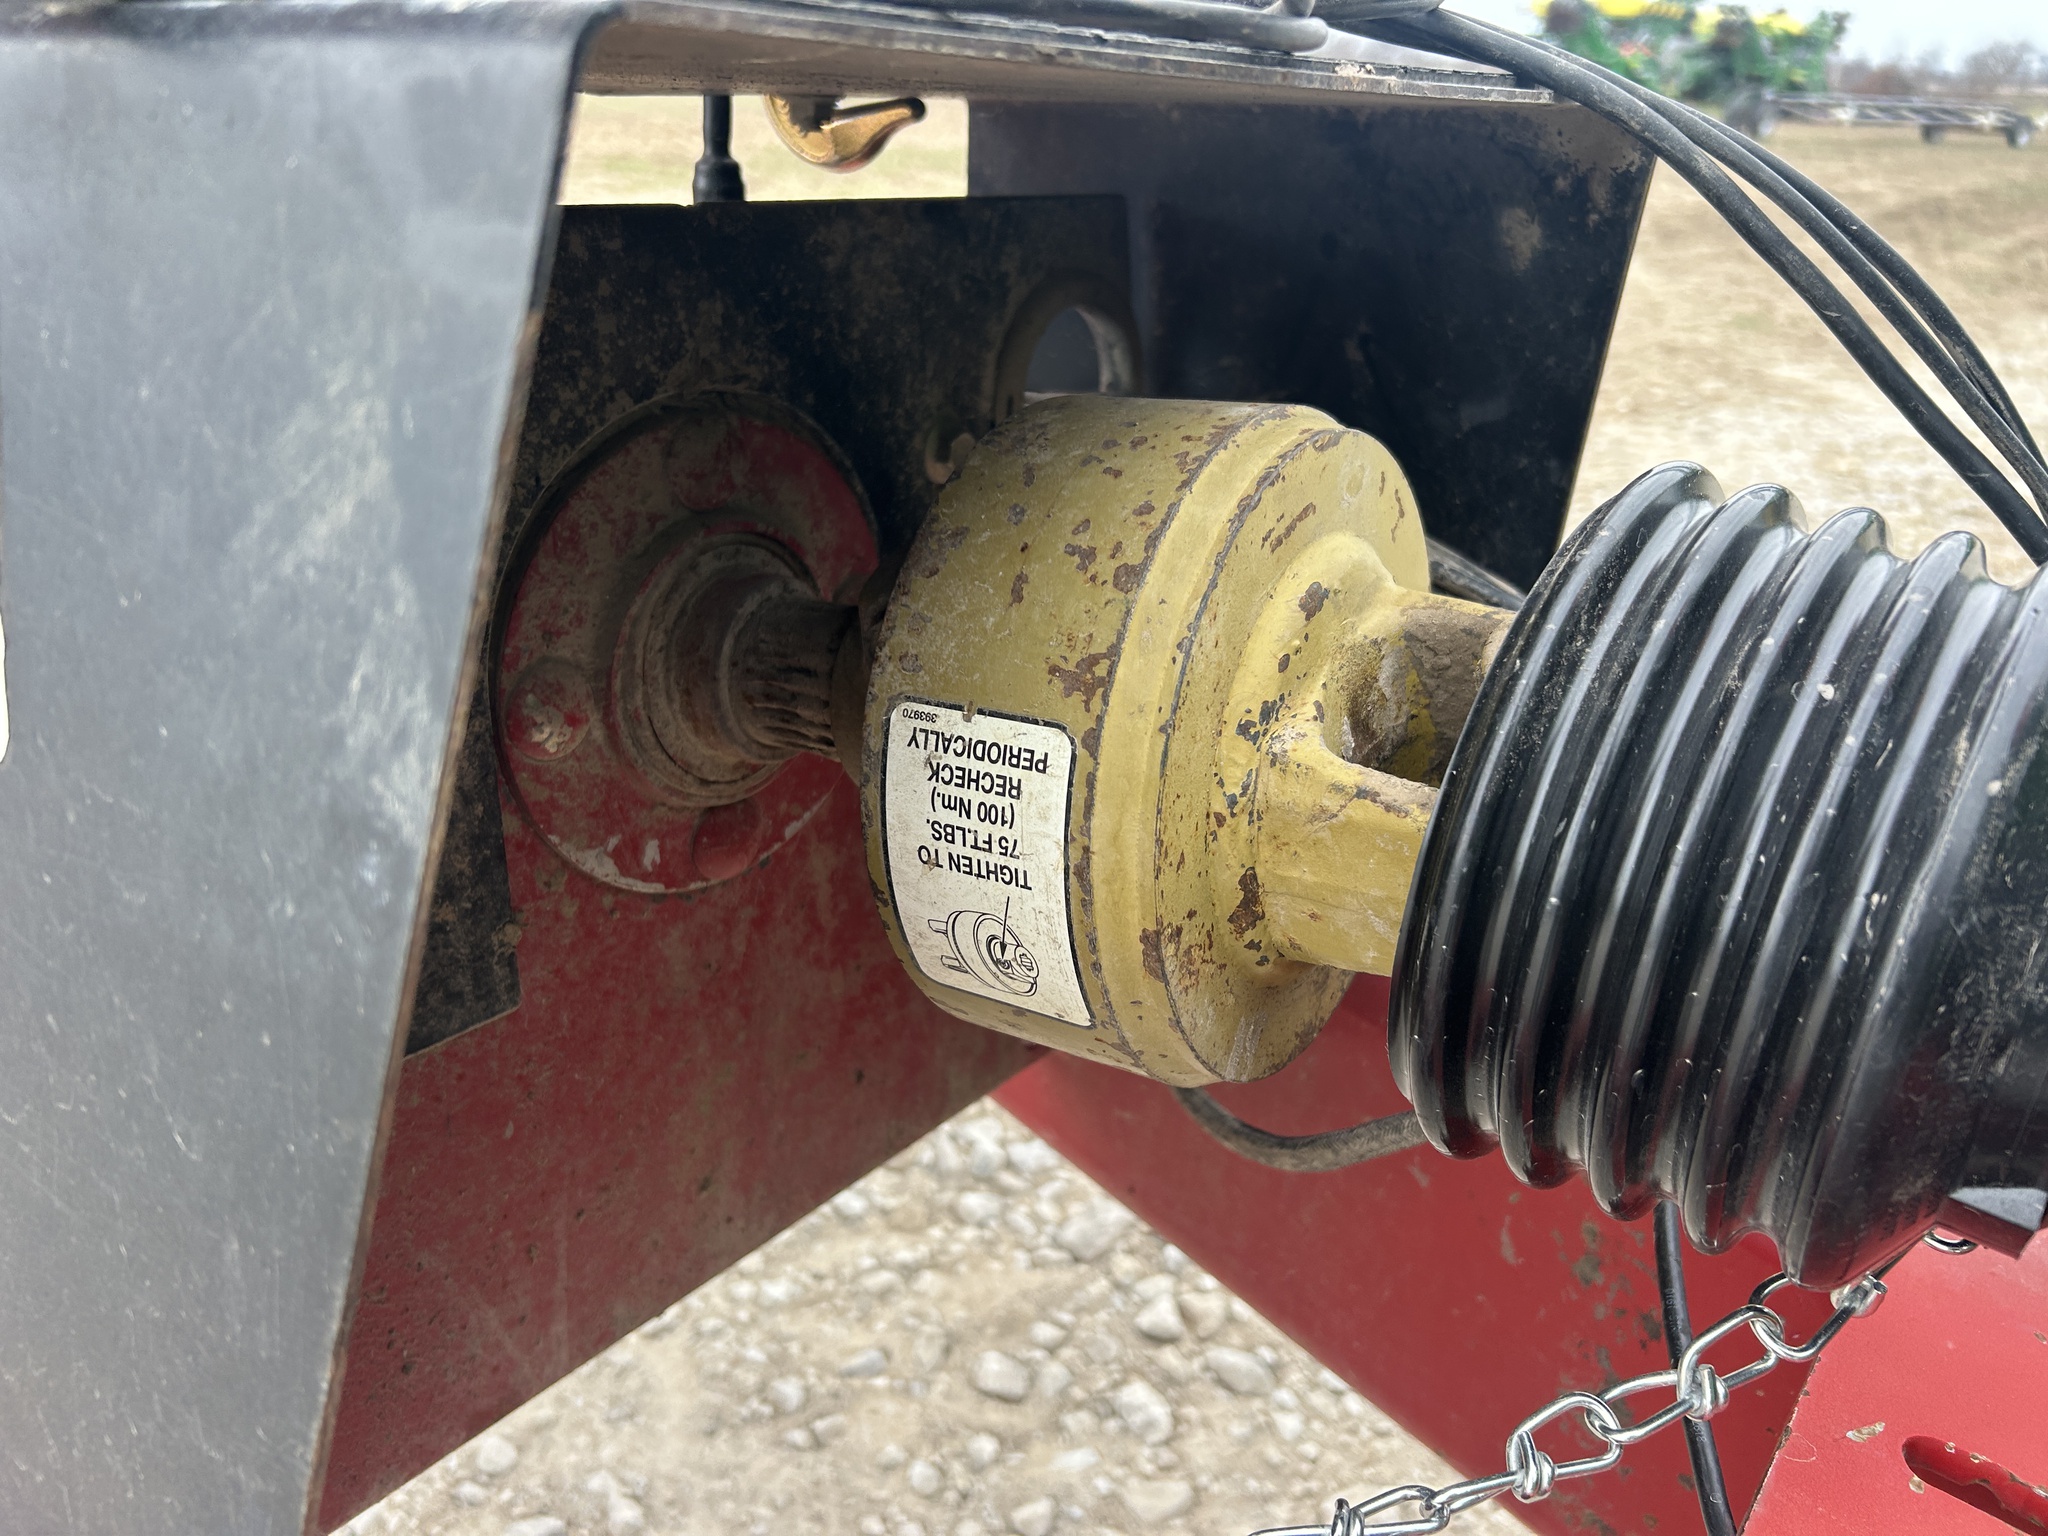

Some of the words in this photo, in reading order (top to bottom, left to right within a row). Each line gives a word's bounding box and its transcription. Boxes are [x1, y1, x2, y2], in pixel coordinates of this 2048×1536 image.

[902, 708, 938, 723] 393970
[907, 726, 1049, 774] PERIODICALLY
[927, 761, 1022, 800] RECHECK
[930, 786, 972, 820] Nm.)
[977, 803, 1015, 829] (100
[917, 845, 943, 868] TO
[999, 836, 1019, 859] 75
[949, 852, 1032, 890] TIGHTEN
